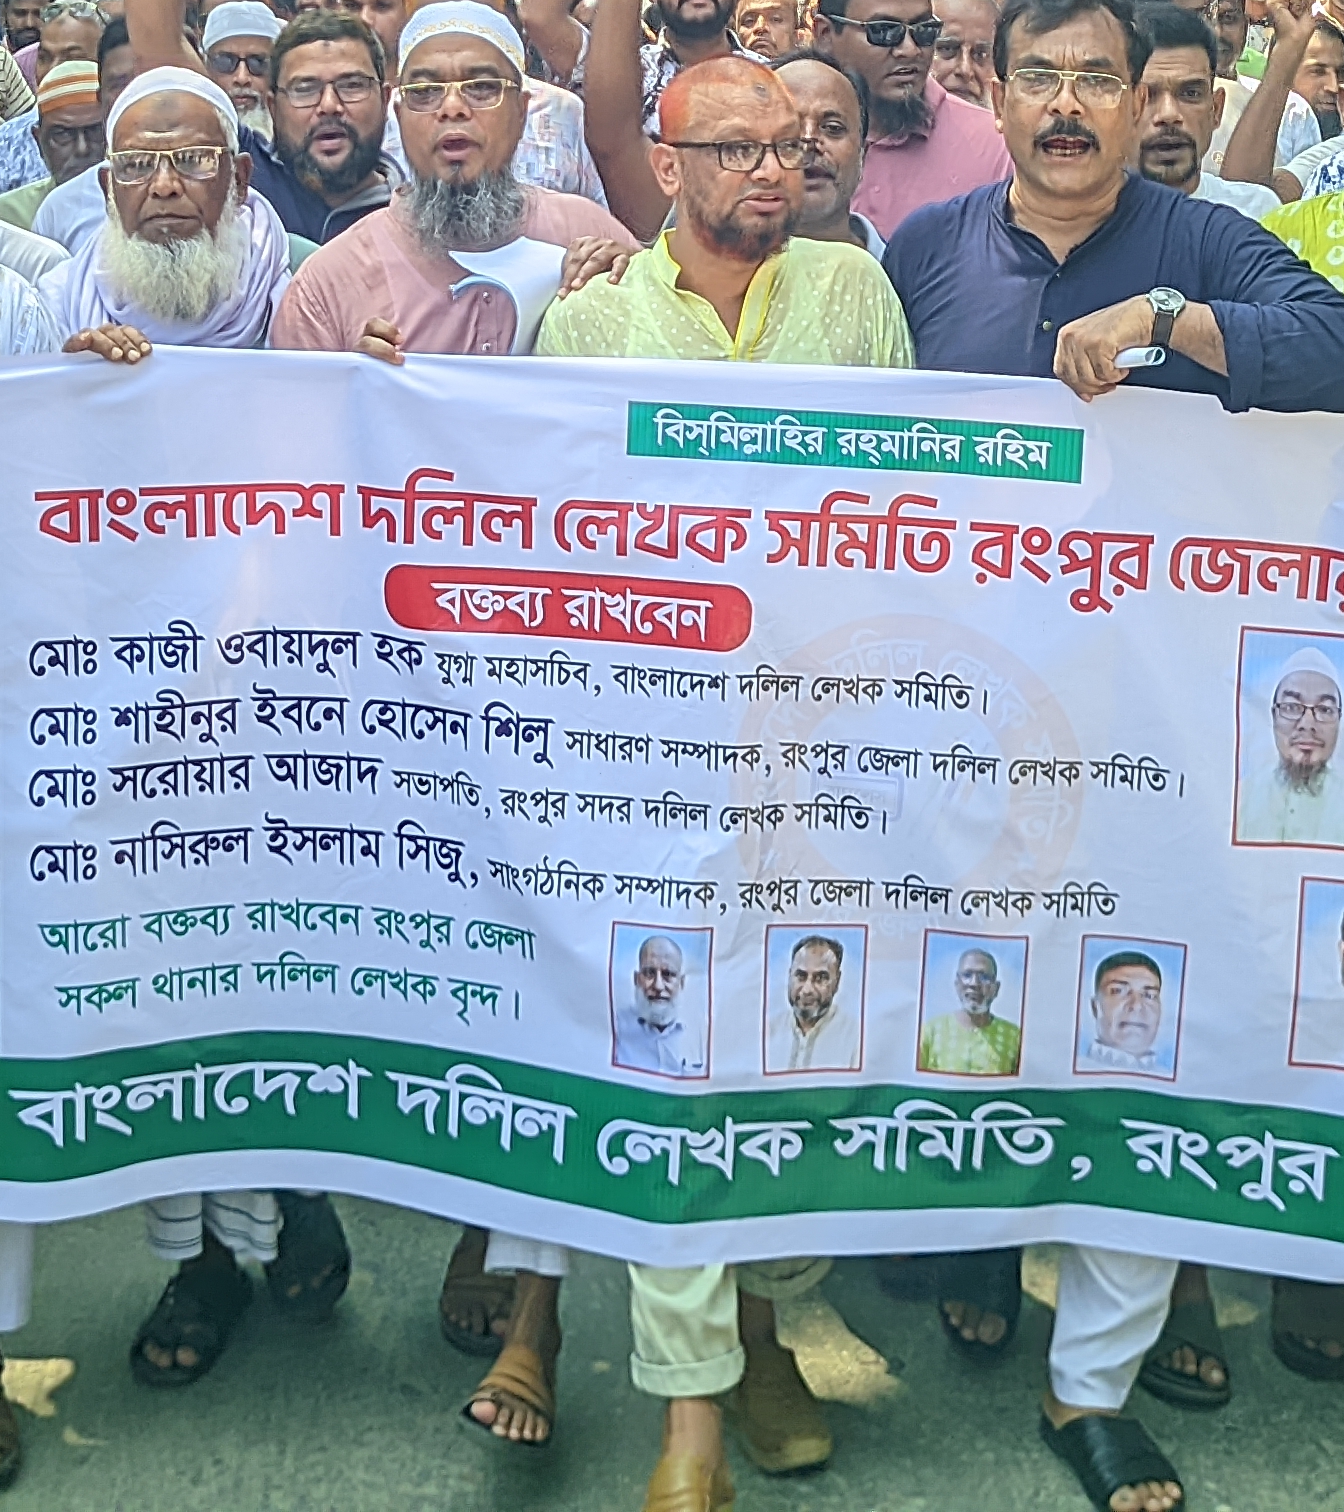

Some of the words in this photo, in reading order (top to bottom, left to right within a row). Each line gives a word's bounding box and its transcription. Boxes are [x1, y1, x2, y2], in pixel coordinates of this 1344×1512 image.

[973, 429, 1052, 471] রহিম
[35, 483, 345, 543] বাংলাদেশ
[358, 467, 537, 550] দলিল
[553, 500, 752, 564] লেখক
[765, 490, 957, 574] সমিতি
[970, 521, 1155, 613] রংপুর
[430, 582, 552, 628] বক্তব্য
[564, 587, 713, 643] রাখবেন
[29, 636, 98, 678] মোঃ
[110, 621, 205, 675] কাজী
[216, 626, 362, 679] ওবায়দুল
[371, 631, 427, 675] হক
[436, 649, 476, 688] যুগ্ম
[612, 661, 727, 704] বাংলাদেশ
[736, 664, 801, 704] দলিল
[812, 673, 886, 704] লেখক
[29, 700, 97, 748] মোঃ
[111, 688, 241, 747] শাহীনুর
[251, 682, 351, 736] ইবনে
[361, 697, 472, 752] হোসেন
[480, 700, 555, 765] শিলু
[564, 727, 653, 764] সাধারণ
[780, 740, 850, 779] রংপুর
[857, 746, 923, 778] জেলা
[930, 749, 1000, 786] দলিল
[1009, 758, 1082, 788] লেখক
[29, 762, 97, 809] মোঃ
[107, 754, 255, 802] সরোয়ার
[263, 748, 384, 796] আজাদ
[499, 788, 568, 827] রংপুর
[576, 794, 635, 826] সদর
[642, 792, 712, 832] দলিল
[719, 803, 785, 835] লেখক
[29, 836, 97, 884] মোঃ
[108, 820, 255, 879] নাসিরুল
[262, 813, 386, 870] ইসলাম
[486, 856, 605, 903] সাংগঠনিক
[739, 877, 800, 918] রংপুর
[809, 877, 875, 913] জেলা
[884, 874, 954, 916] দলিল
[961, 886, 1035, 918] লেখক
[1043, 879, 1119, 919] সমিতি
[38, 913, 132, 956] আরো
[140, 904, 237, 940] বক্তব্য
[244, 898, 362, 937] রাখবেন
[372, 908, 456, 952] রংপুর
[466, 920, 538, 961] জেলা
[55, 977, 140, 1016] সকল
[150, 963, 243, 1002] থানার
[251, 951, 339, 990] দলিল
[351, 966, 440, 1004] লেখক
[9, 1058, 372, 1148] বাংলাদেশ
[386, 1064, 578, 1165] দলিল
[596, 1115, 813, 1187] লেখক
[1121, 1116, 1339, 1212] রংপুর
